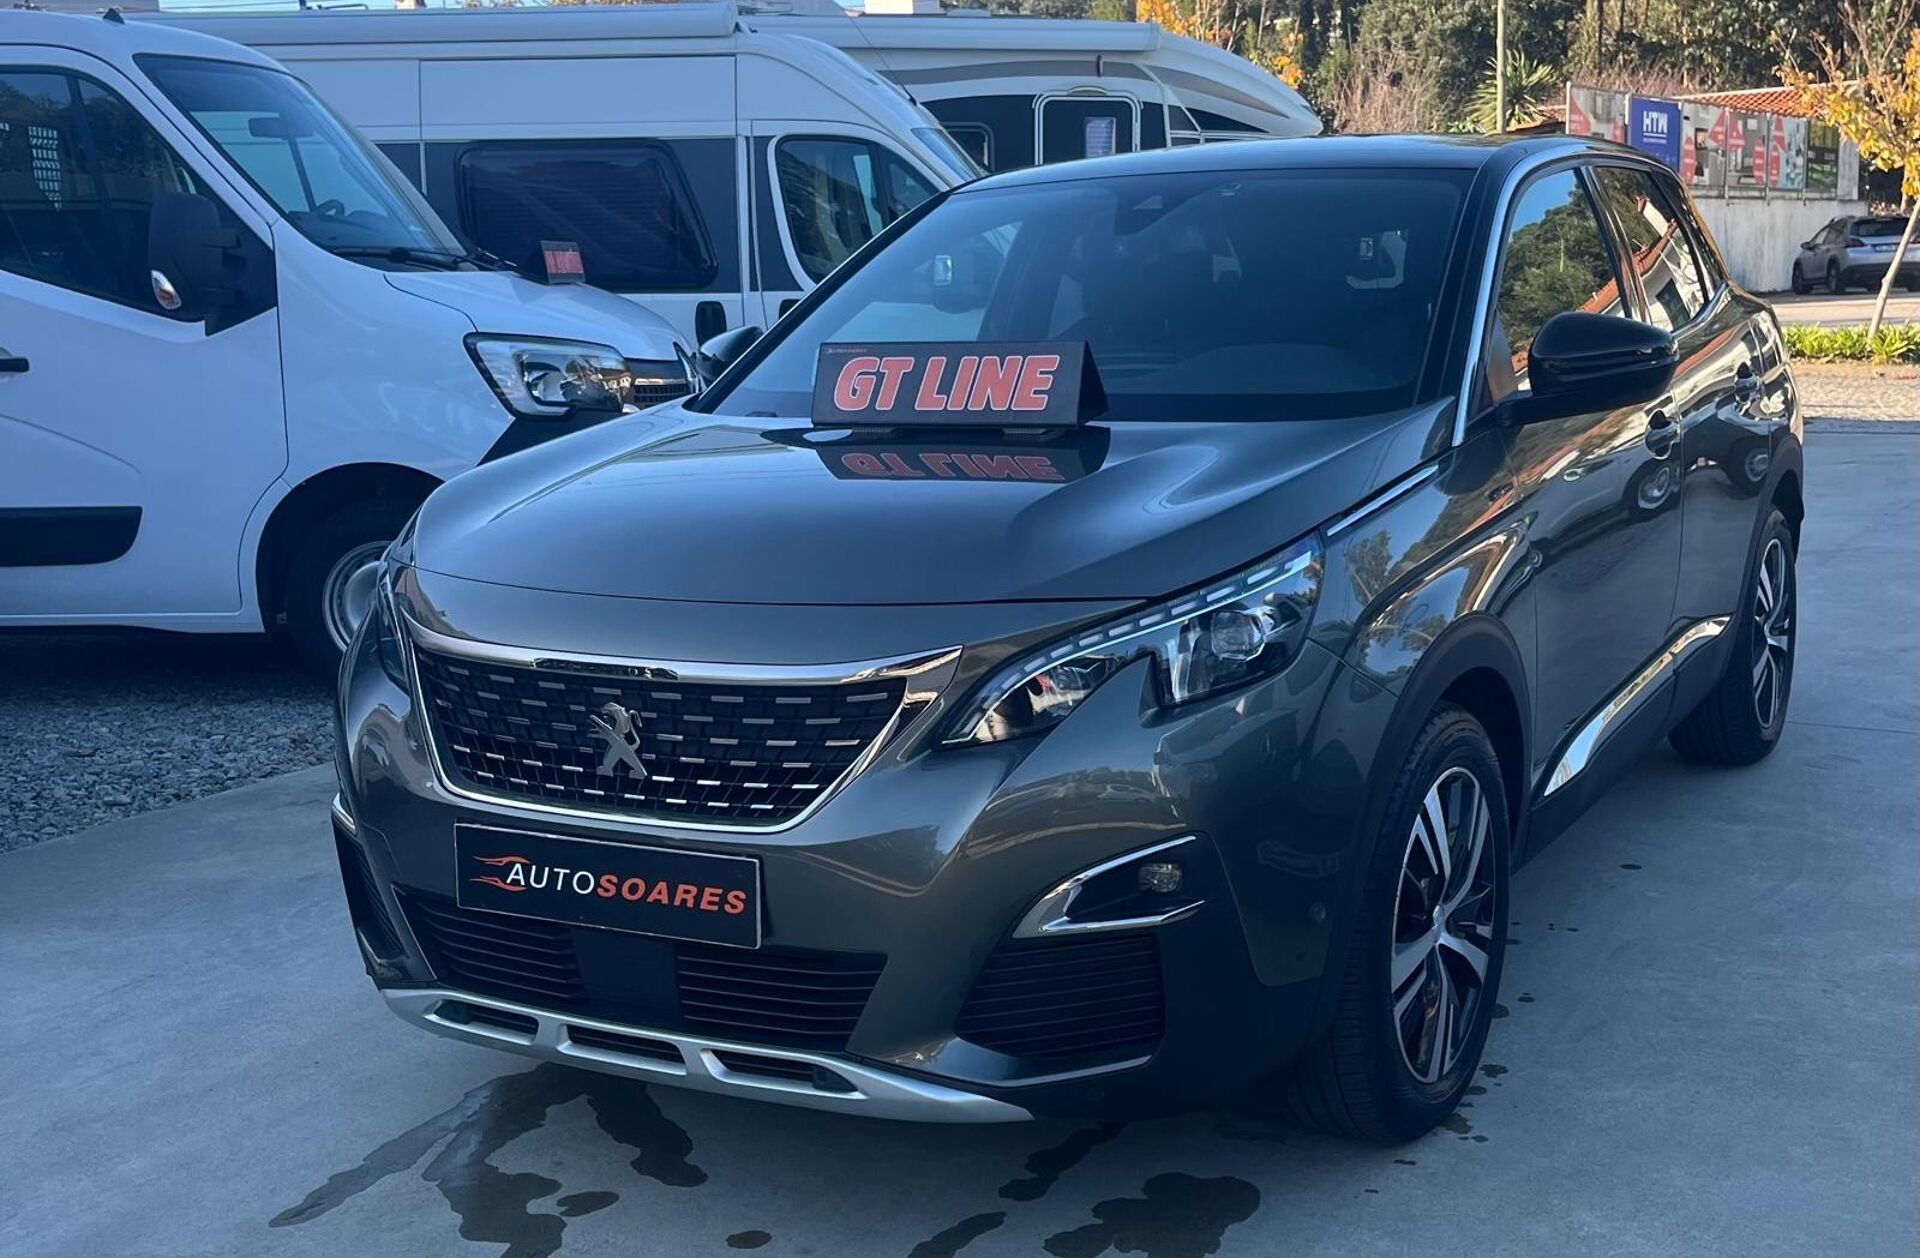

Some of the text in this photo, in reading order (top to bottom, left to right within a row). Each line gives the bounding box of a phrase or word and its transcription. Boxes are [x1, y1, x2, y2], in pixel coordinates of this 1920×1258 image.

[834, 354, 1061, 411] GT LINE
[505, 862, 747, 915] AUTOSOARES
